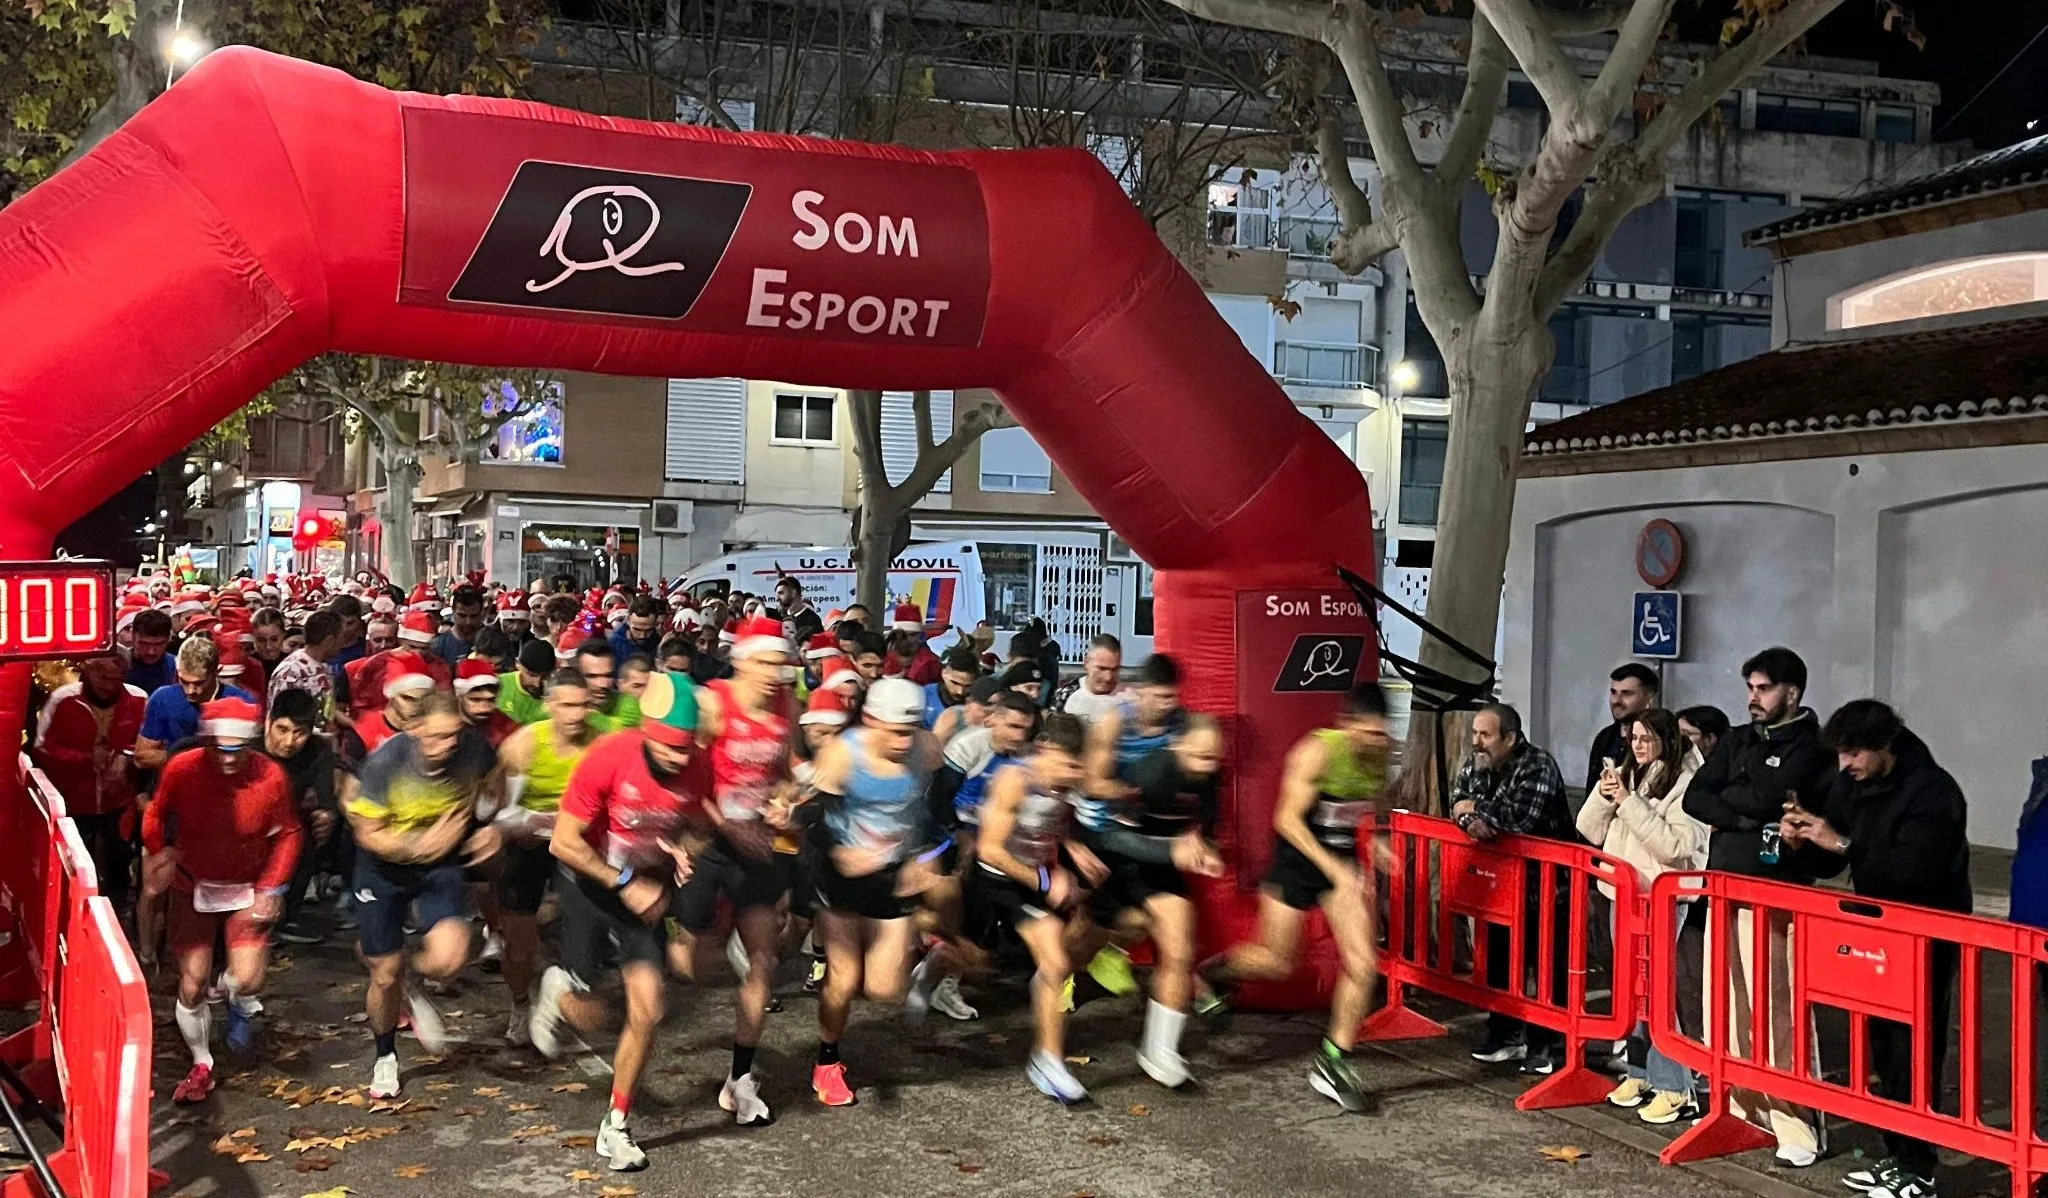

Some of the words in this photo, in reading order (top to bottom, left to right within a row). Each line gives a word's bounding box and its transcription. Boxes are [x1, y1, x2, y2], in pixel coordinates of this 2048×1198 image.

[888, 558, 959, 569] MOVIL
[801, 595, 840, 603] uropeos
[1320, 594, 1368, 617] ESPOR
[0, 577, 97, 645] 00
